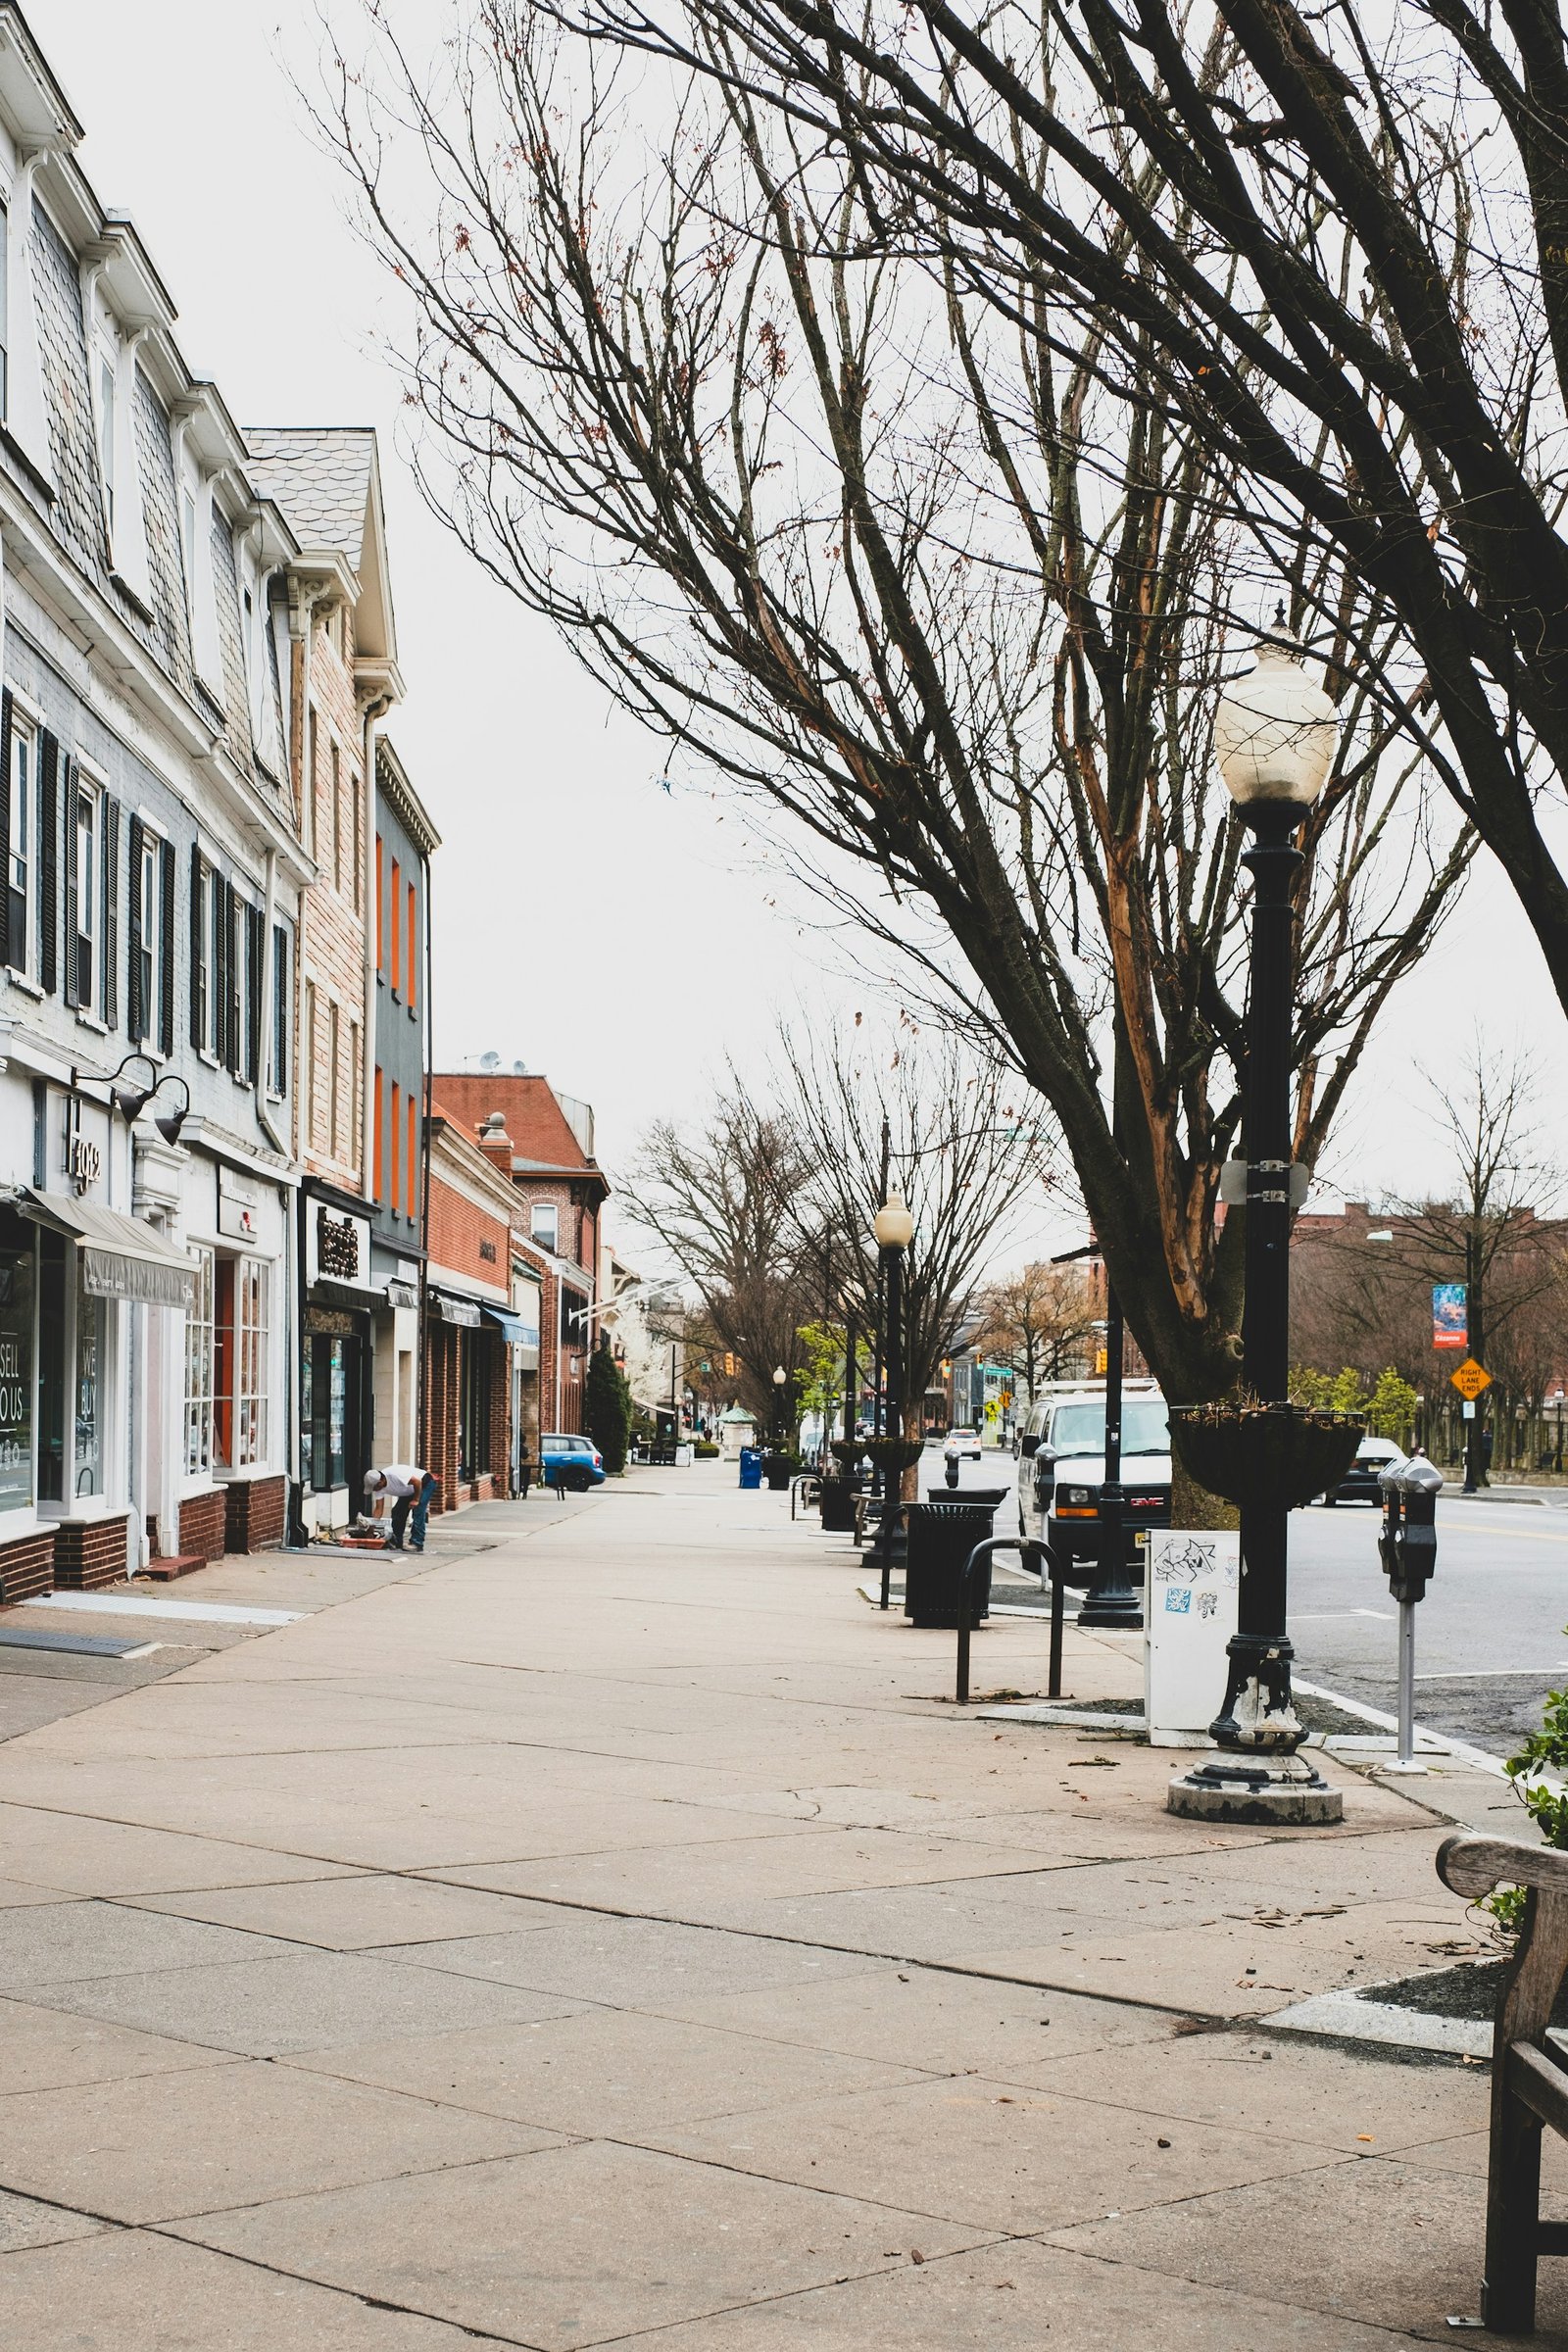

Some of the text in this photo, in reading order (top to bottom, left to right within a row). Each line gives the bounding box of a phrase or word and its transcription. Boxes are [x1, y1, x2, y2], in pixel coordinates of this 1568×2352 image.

[0, 1345, 19, 1378] SELL
[82, 1347, 96, 1376] WE
[10, 1387, 23, 1421] US
[81, 1385, 96, 1415] BUY
[1130, 1496, 1164, 1506] GMC
